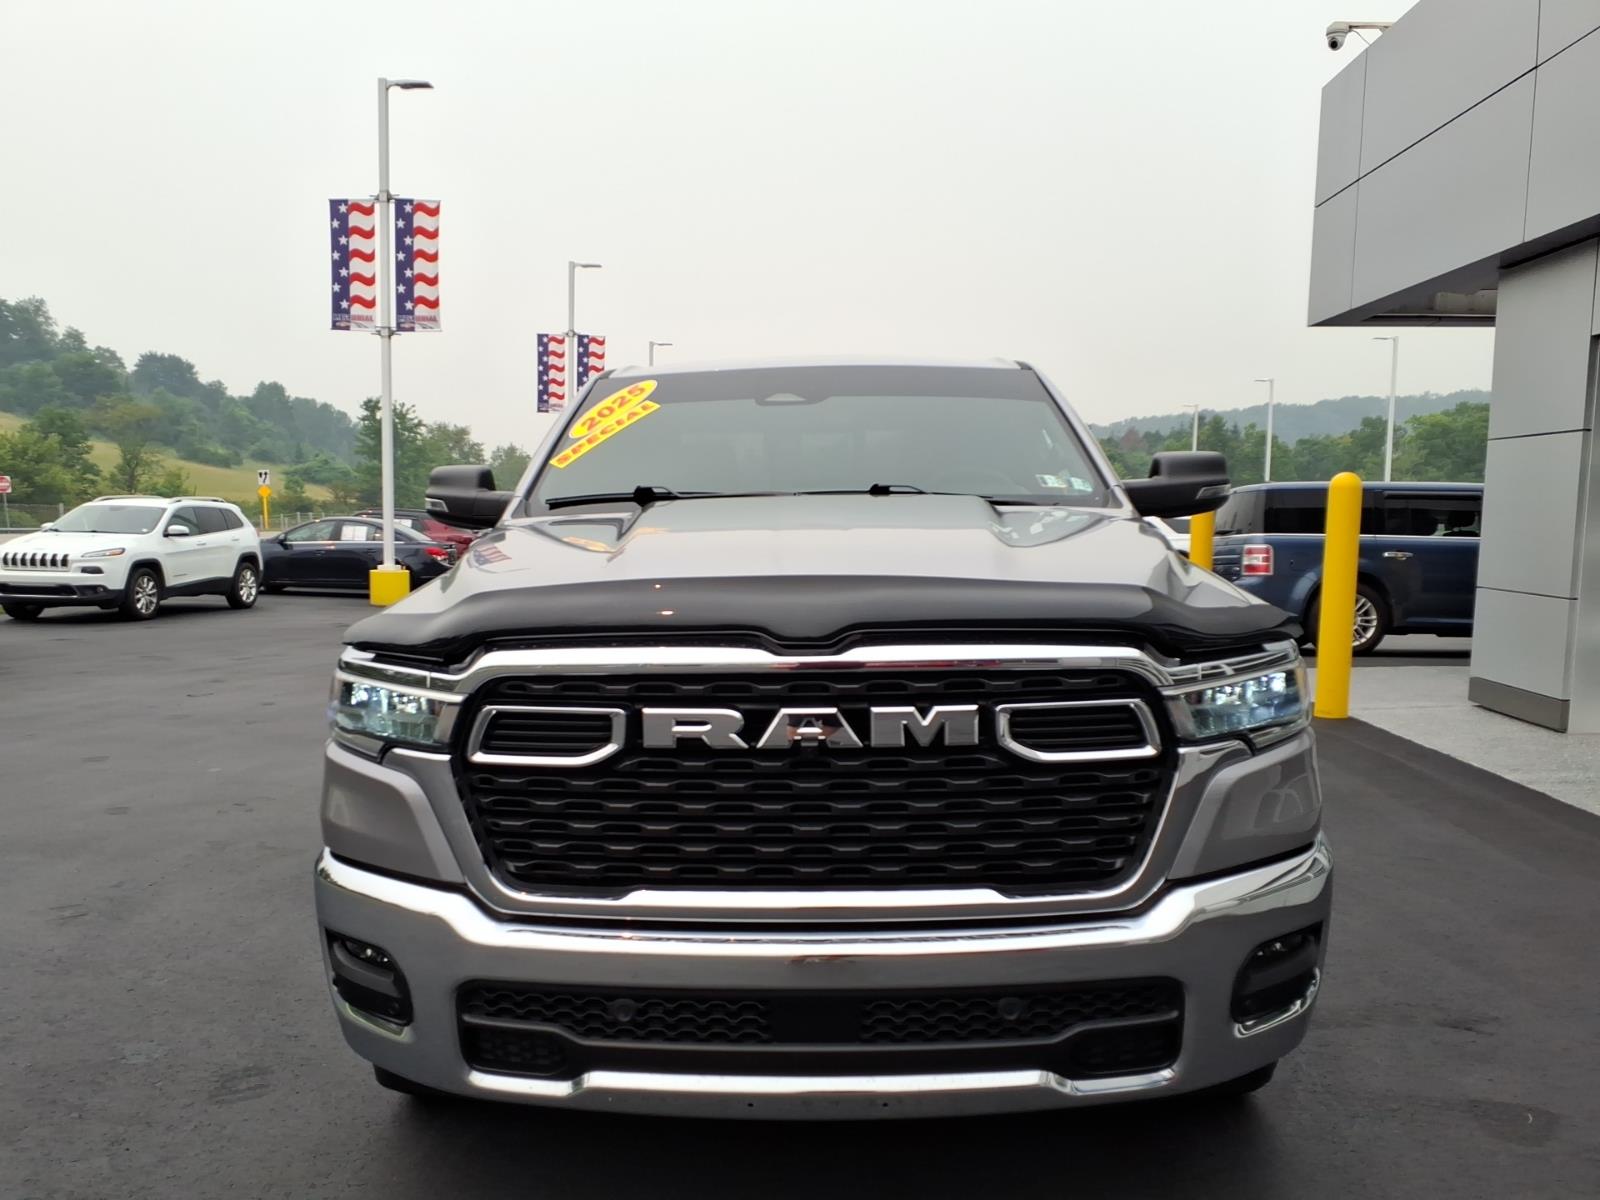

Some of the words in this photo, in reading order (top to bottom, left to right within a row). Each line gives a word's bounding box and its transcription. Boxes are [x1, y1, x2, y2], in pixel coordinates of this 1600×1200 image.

[581, 385, 646, 431] 2025
[556, 402, 656, 465] SPECIAL
[642, 704, 980, 749] RAM
